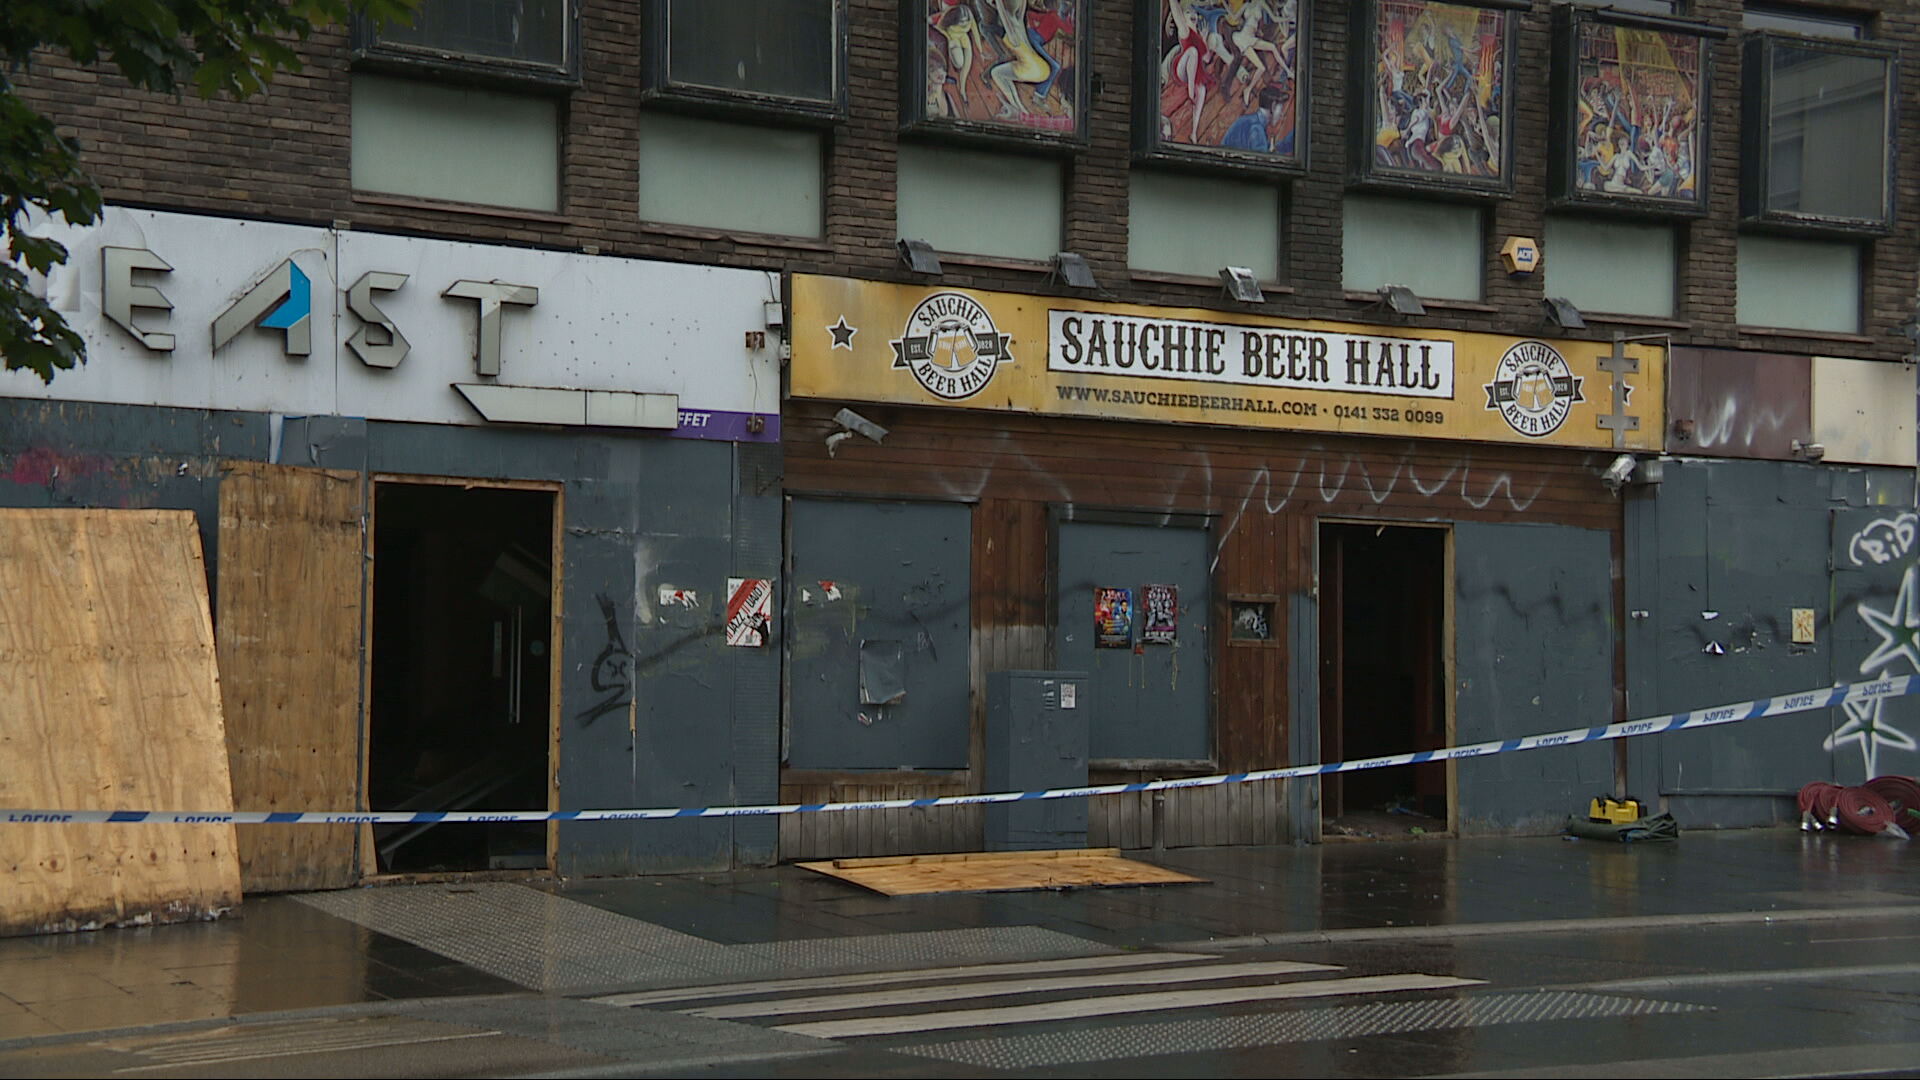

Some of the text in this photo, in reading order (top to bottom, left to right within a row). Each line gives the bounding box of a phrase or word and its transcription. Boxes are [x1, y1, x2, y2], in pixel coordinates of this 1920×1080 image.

[918, 298, 982, 327] SAUCHIE
[1060, 316, 1440, 390] SAUCHIE BEER HALL
[1505, 344, 1560, 372] SAUCHIE
[918, 358, 992, 394] BEER HALL
[1056, 385, 1444, 425] WWW.SAUCHIEBEERHALL.COM 0141 332 0099
[1506, 399, 1566, 432] BEER HALL
